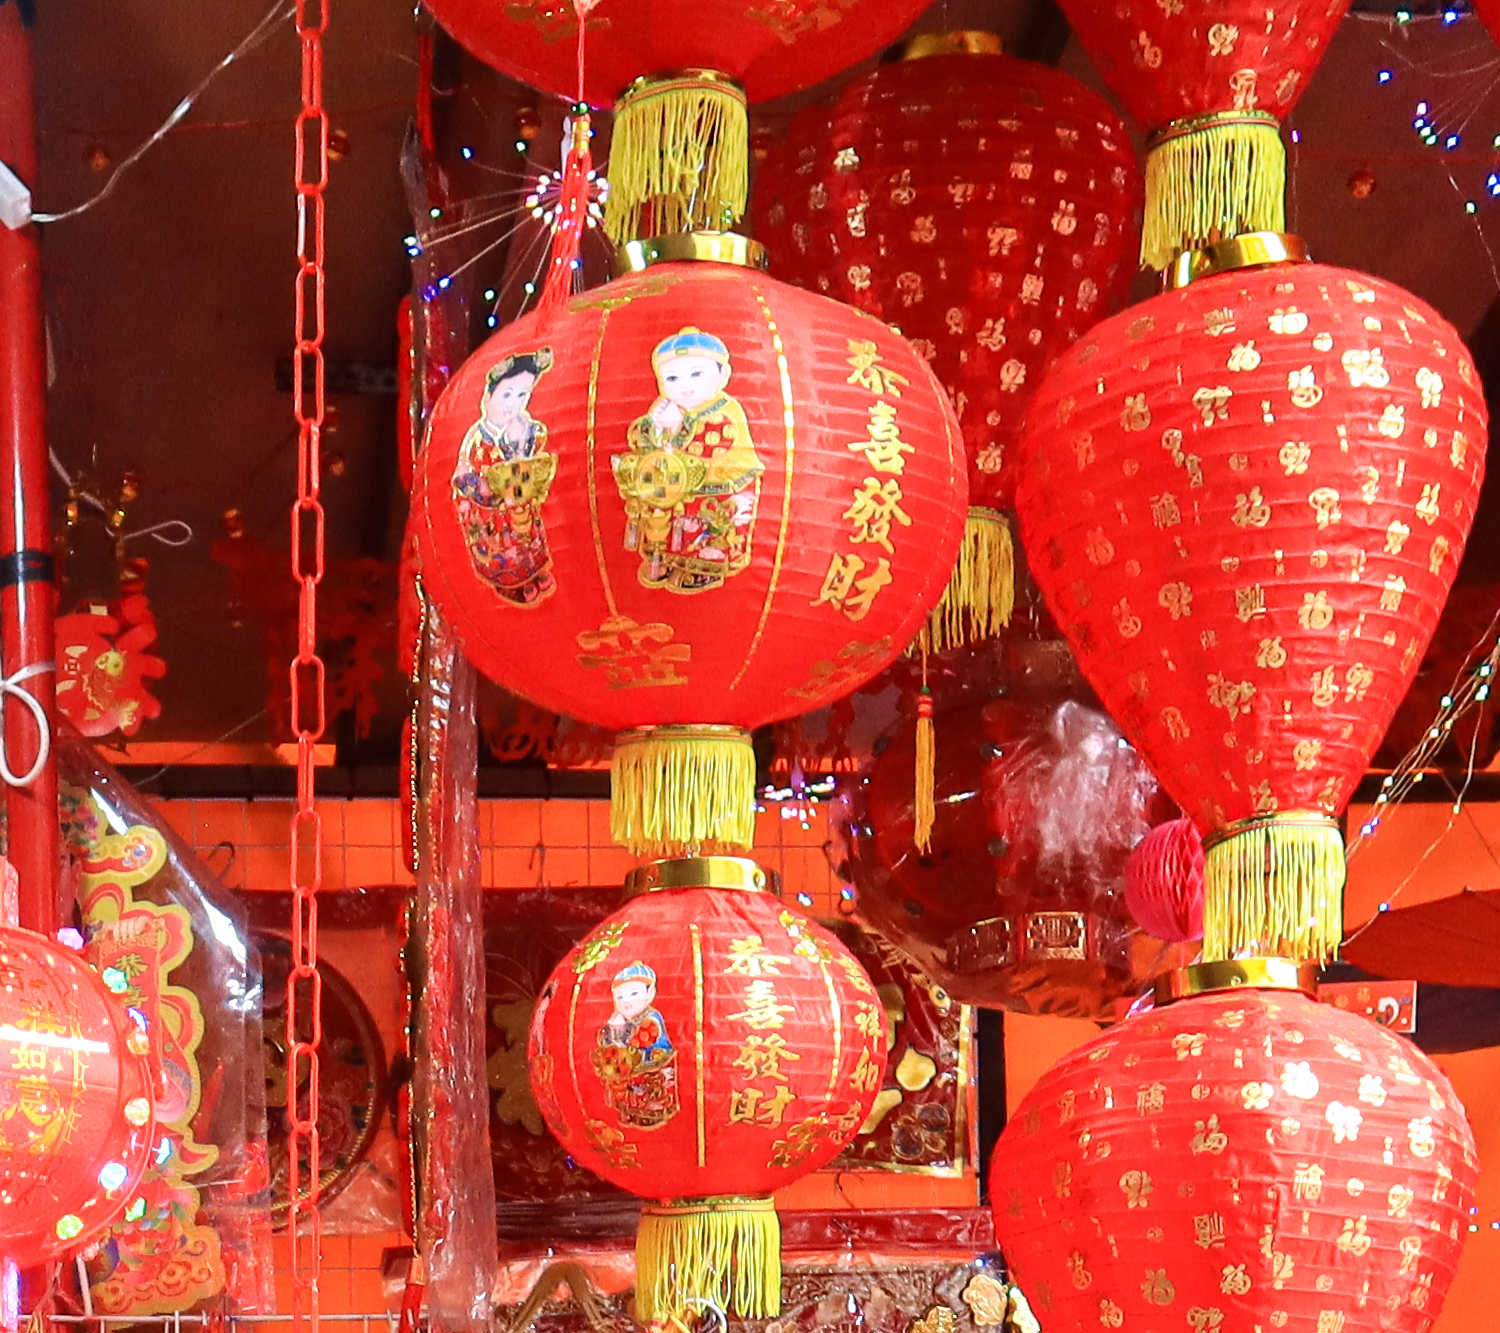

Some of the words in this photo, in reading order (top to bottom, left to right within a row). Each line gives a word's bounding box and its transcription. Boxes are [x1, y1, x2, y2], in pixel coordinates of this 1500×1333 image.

[809, 339, 916, 622] 恭喜發財
[723, 935, 800, 1126] 恭喜發財
